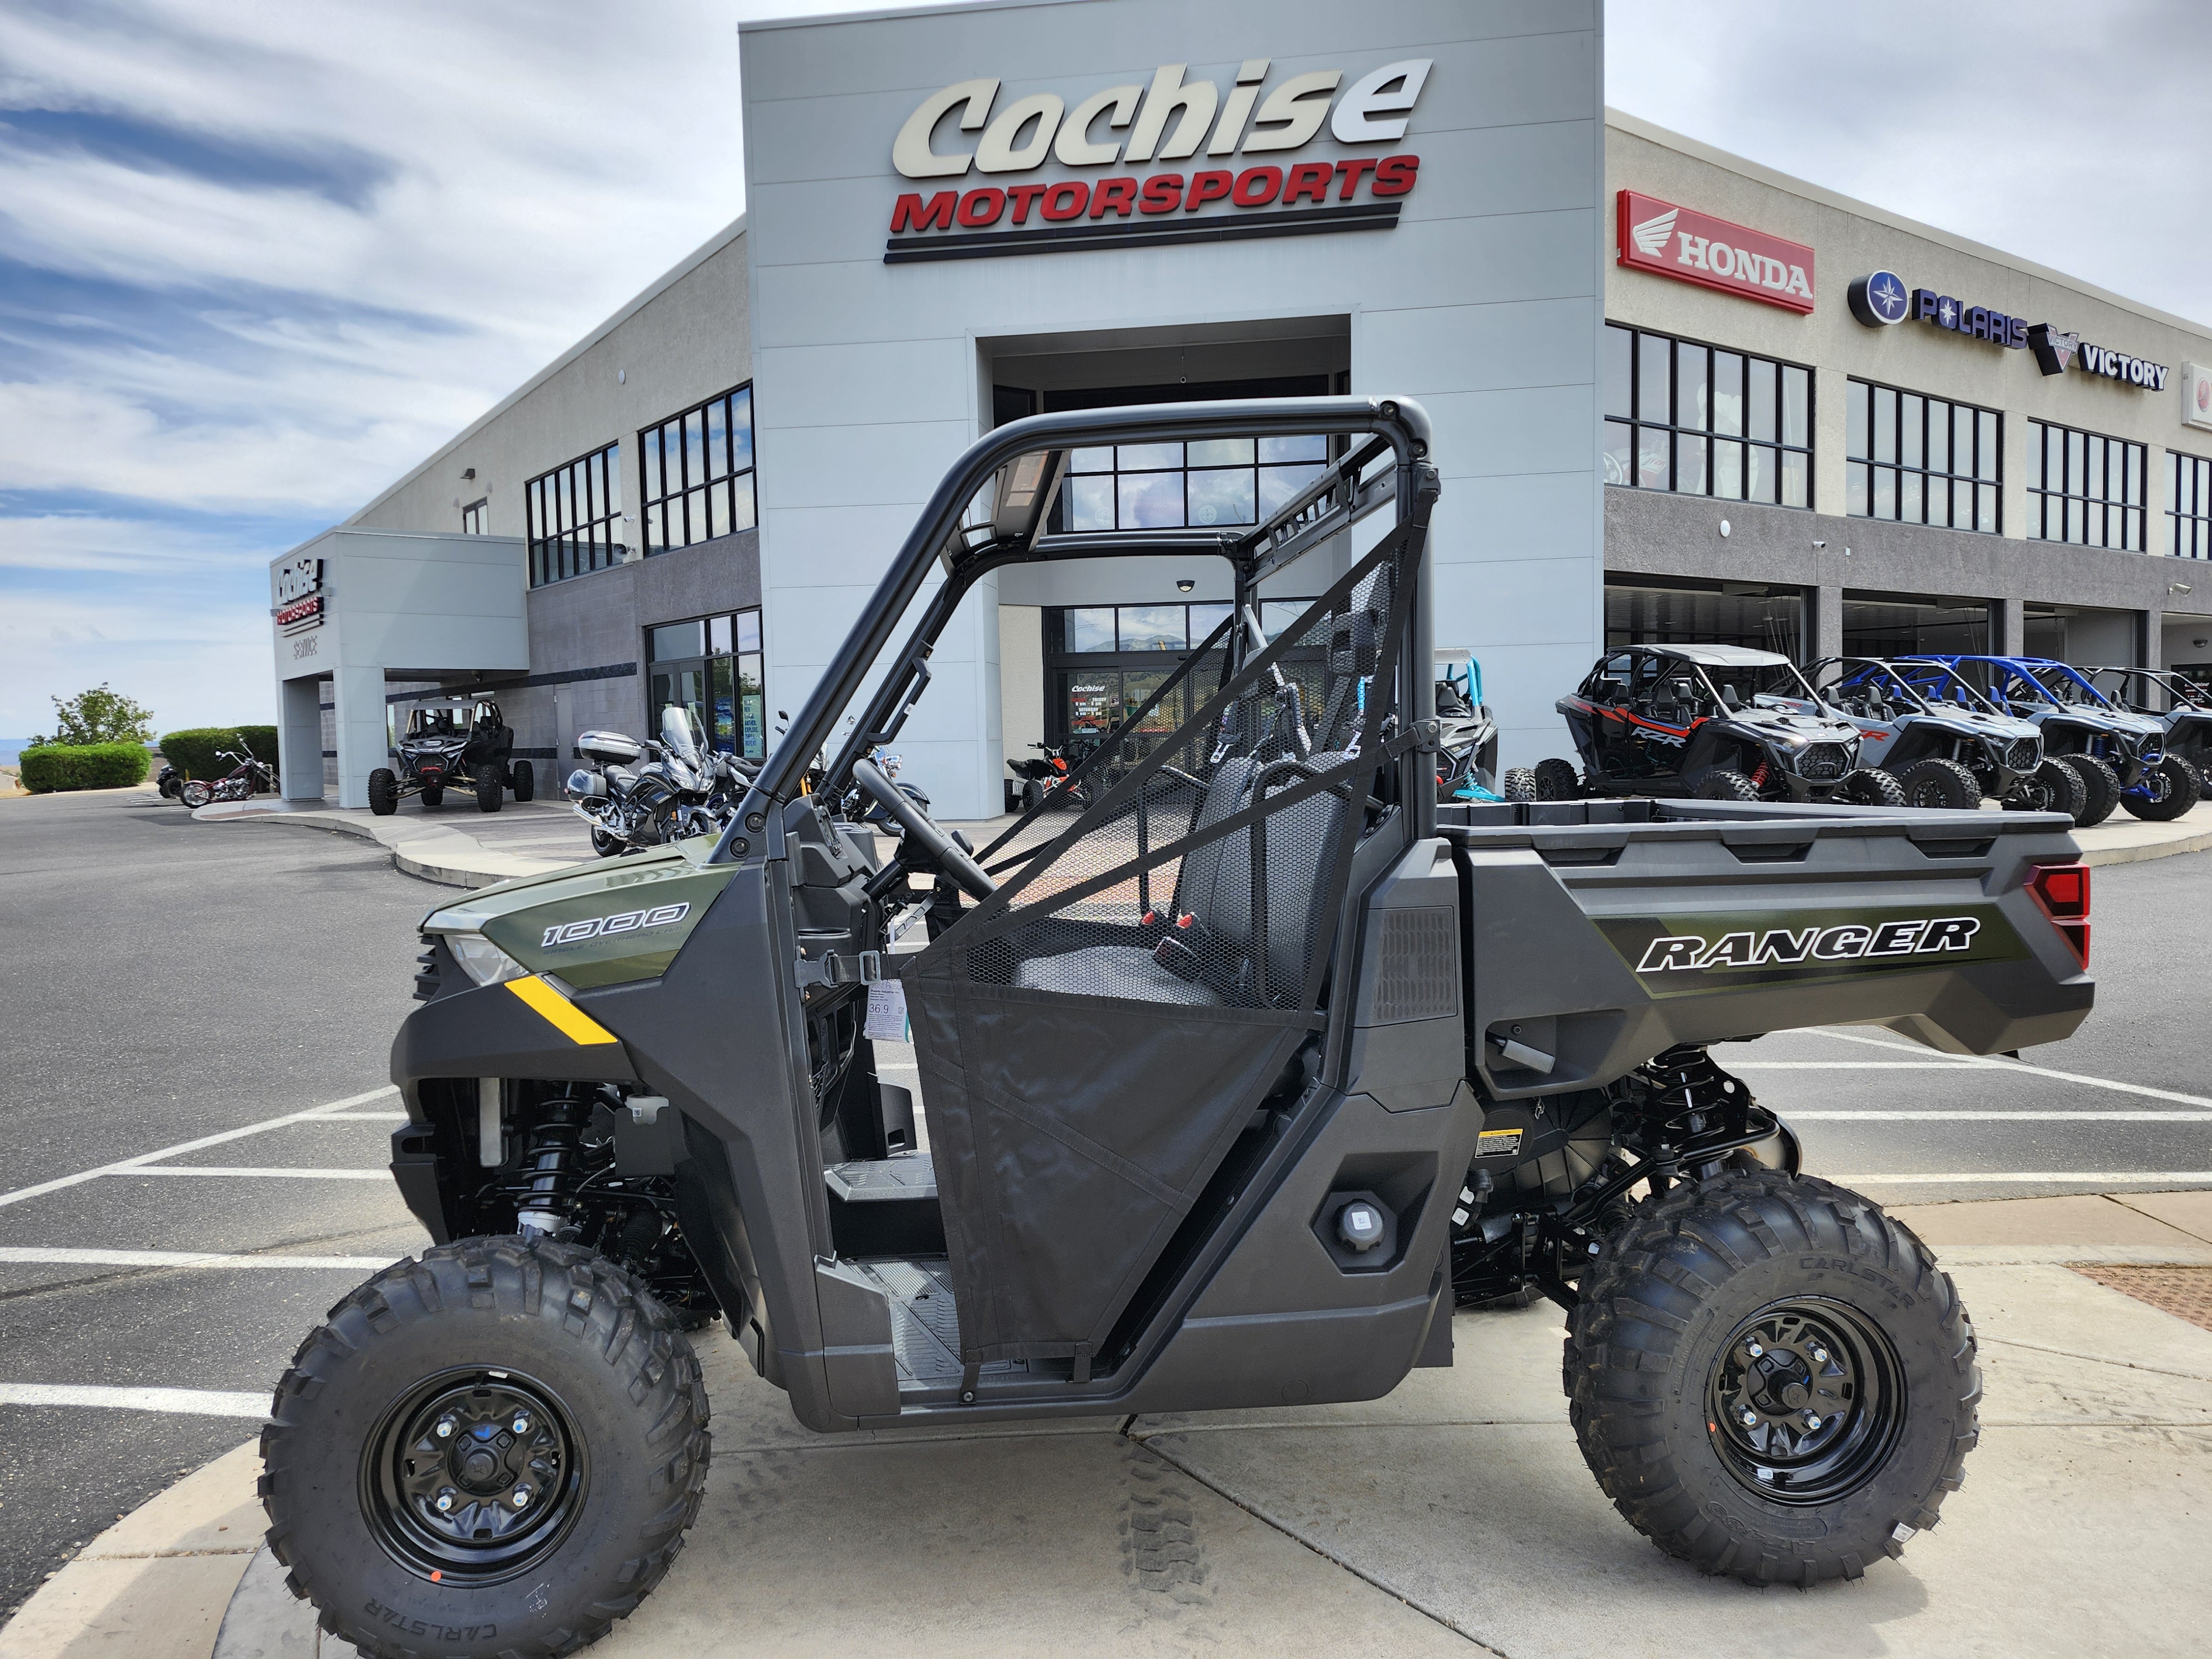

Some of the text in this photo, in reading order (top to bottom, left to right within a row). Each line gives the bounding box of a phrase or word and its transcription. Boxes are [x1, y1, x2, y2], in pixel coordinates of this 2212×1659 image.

[891, 59, 1433, 178] Cochise
[889, 155, 1421, 232] MOTORSPORTS
[1677, 231, 1814, 300] HONDA
[1914, 289, 2028, 349] POLARIS
[2048, 335, 2078, 350] VICTORY
[2083, 344, 2169, 390] VICTORY
[277, 559, 319, 606] Cochise
[277, 597, 320, 625] MOTORSPORTS
[1631, 726, 1687, 748] RZR
[541, 902, 690, 947] 1000
[589, 931, 654, 947] OVERHEAD
[655, 926, 683, 936] CAM
[1635, 916, 1981, 973] RANGER
[869, 1003, 889, 1014] 36.9
[1799, 1257, 1916, 1310] CARLSTAR
[364, 1597, 497, 1641] CARLSTAR
